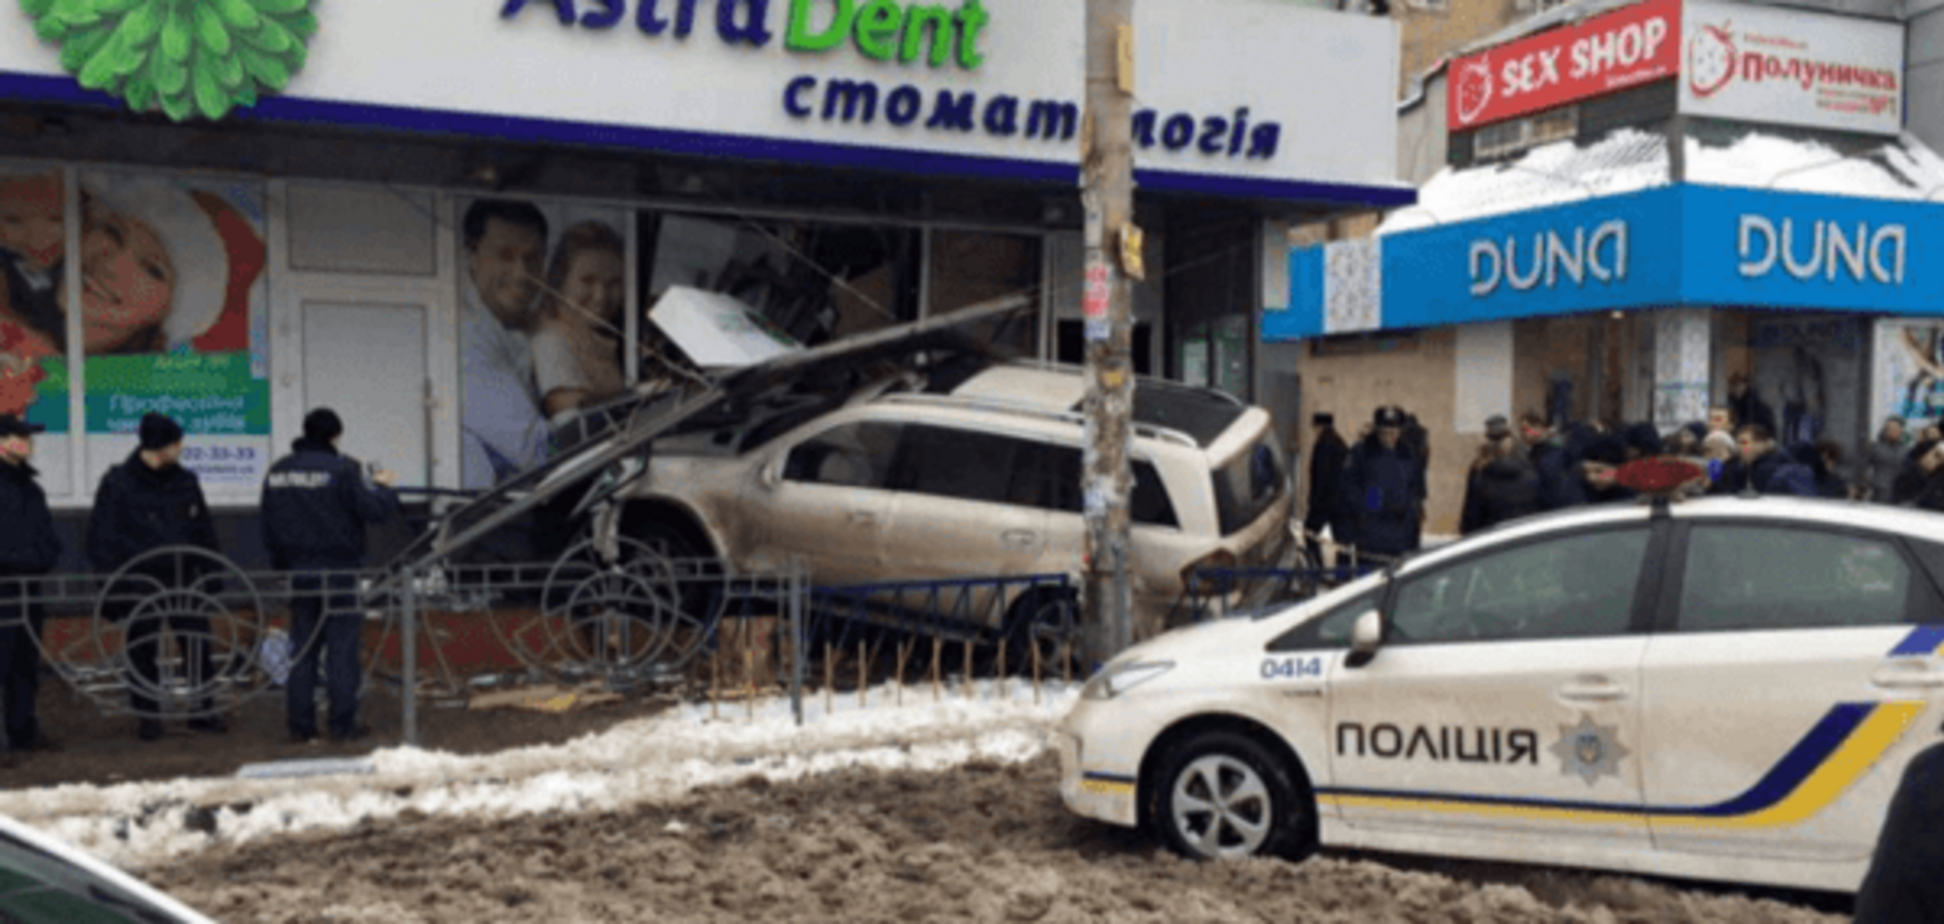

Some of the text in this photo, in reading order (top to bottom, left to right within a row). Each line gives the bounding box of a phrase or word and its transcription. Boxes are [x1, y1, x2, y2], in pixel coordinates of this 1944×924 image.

[1502, 46, 1561, 97] SEX
[1570, 16, 1668, 80] SHOP
[1742, 51, 1898, 91] Полуничка
[783, 75, 1281, 160] стоматлогія
[1260, 657, 1321, 679] 0414
[1336, 722, 1538, 765] ПОЛІЦІЯ
